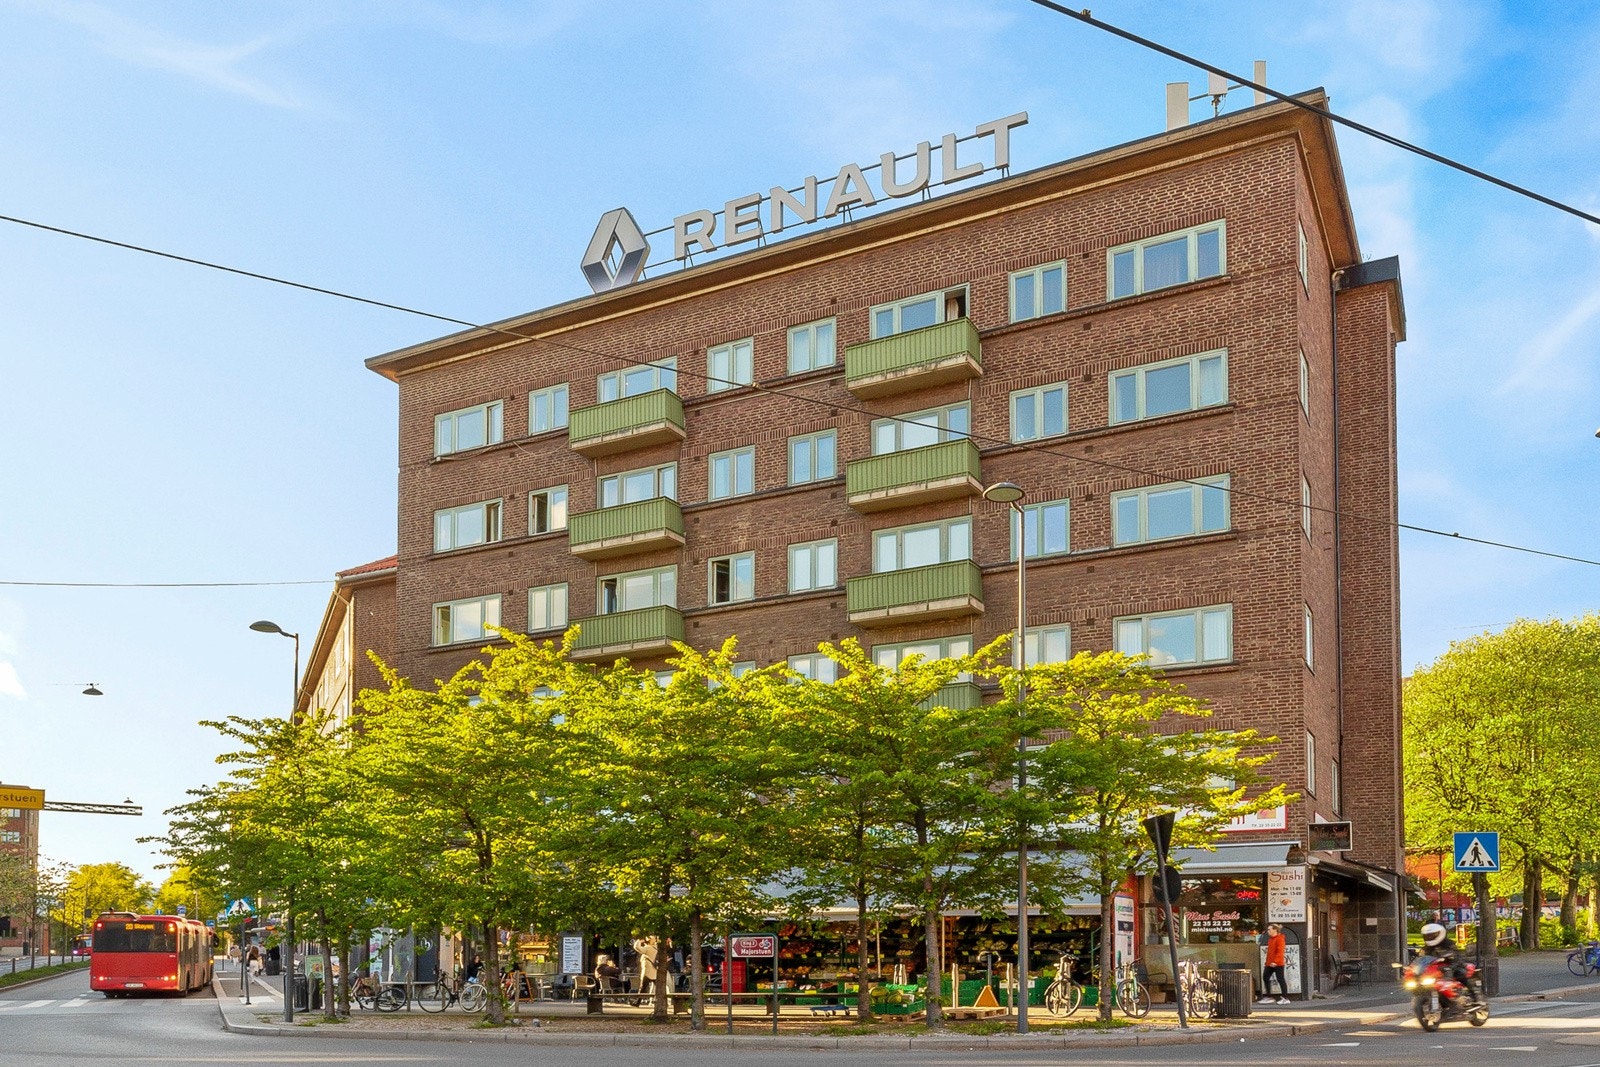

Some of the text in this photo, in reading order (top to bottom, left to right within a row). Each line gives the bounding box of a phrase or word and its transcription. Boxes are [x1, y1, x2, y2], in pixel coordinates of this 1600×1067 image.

[673, 111, 1028, 261] RENAULT
[0, 793, 37, 803] stuen
[1269, 870, 1303, 882] Sushi
[1237, 890, 1259, 899] OPEN
[1184, 910, 1241, 921] Mini Sushi
[740, 948, 772, 956] Majorstuen
